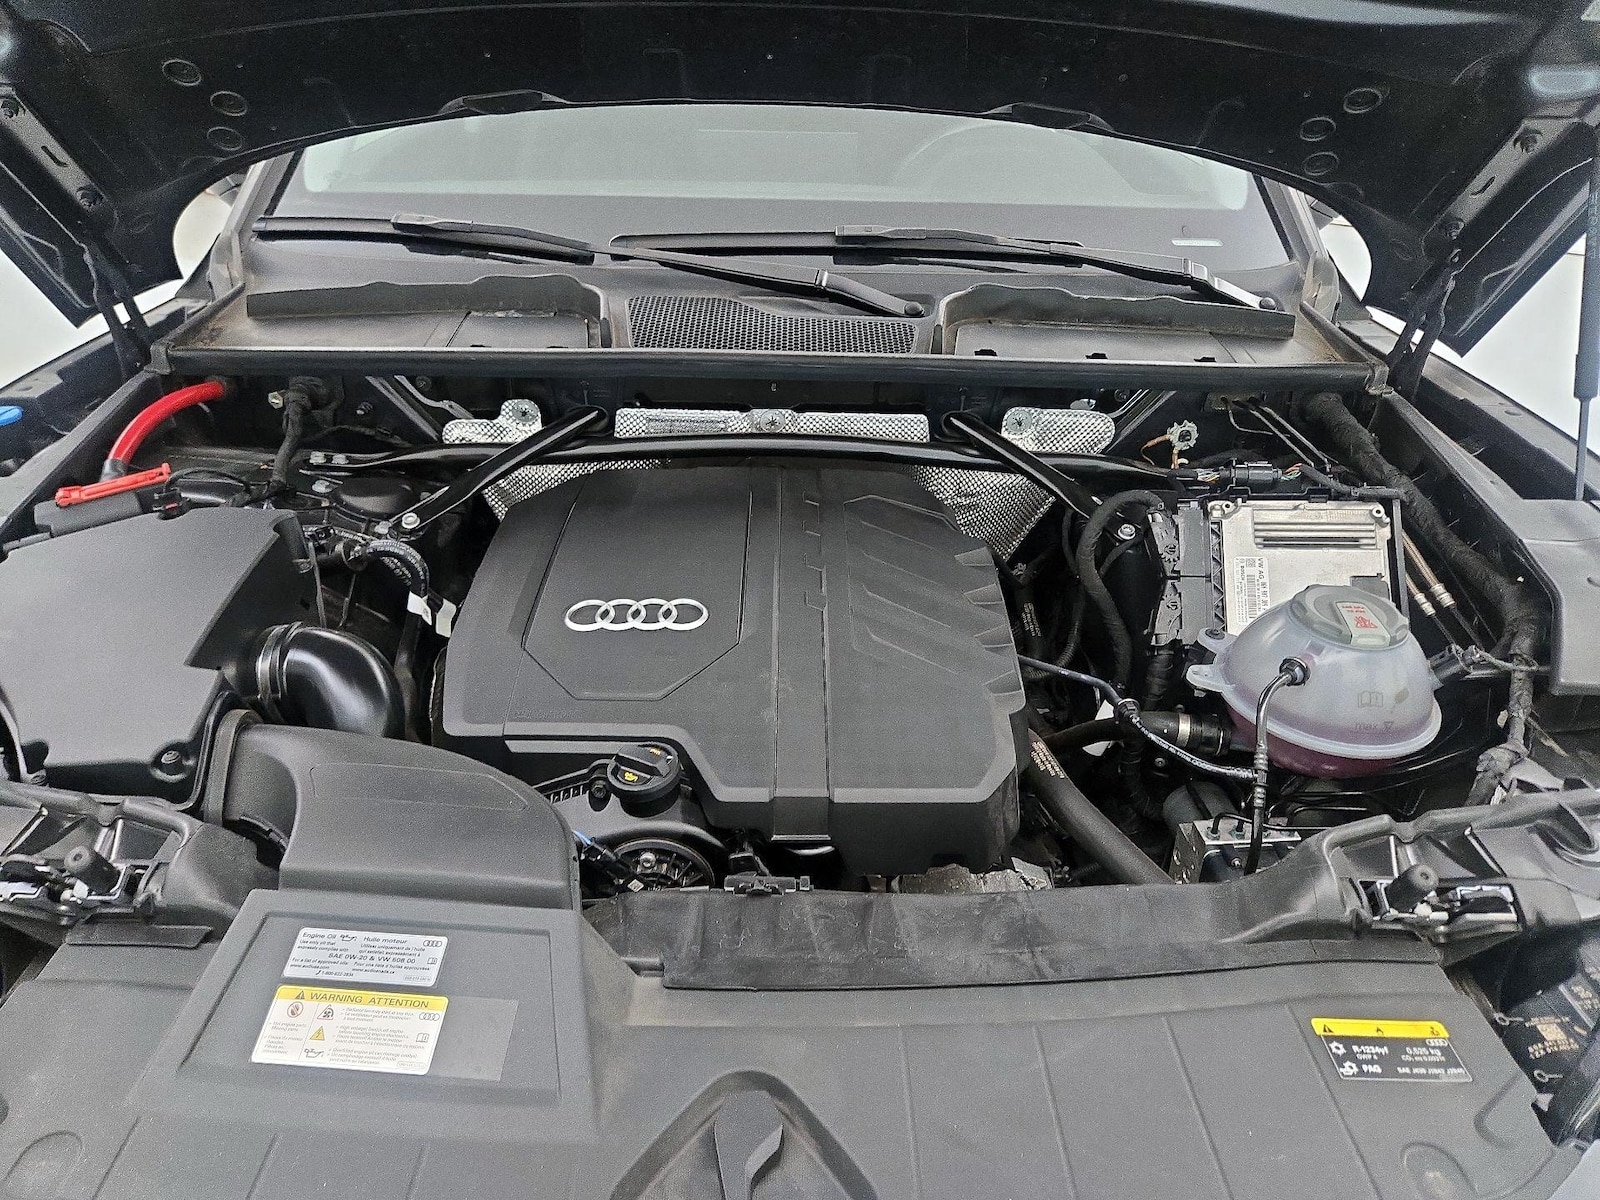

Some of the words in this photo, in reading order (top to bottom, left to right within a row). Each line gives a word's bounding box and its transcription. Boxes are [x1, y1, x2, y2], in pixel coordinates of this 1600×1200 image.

[1258, 569, 1265, 580] AG
[310, 992, 363, 1004] WARNING
[368, 996, 430, 1008] ATTENTION
[1428, 1047, 1442, 1057] kg
[1361, 1064, 1382, 1074] PAG
